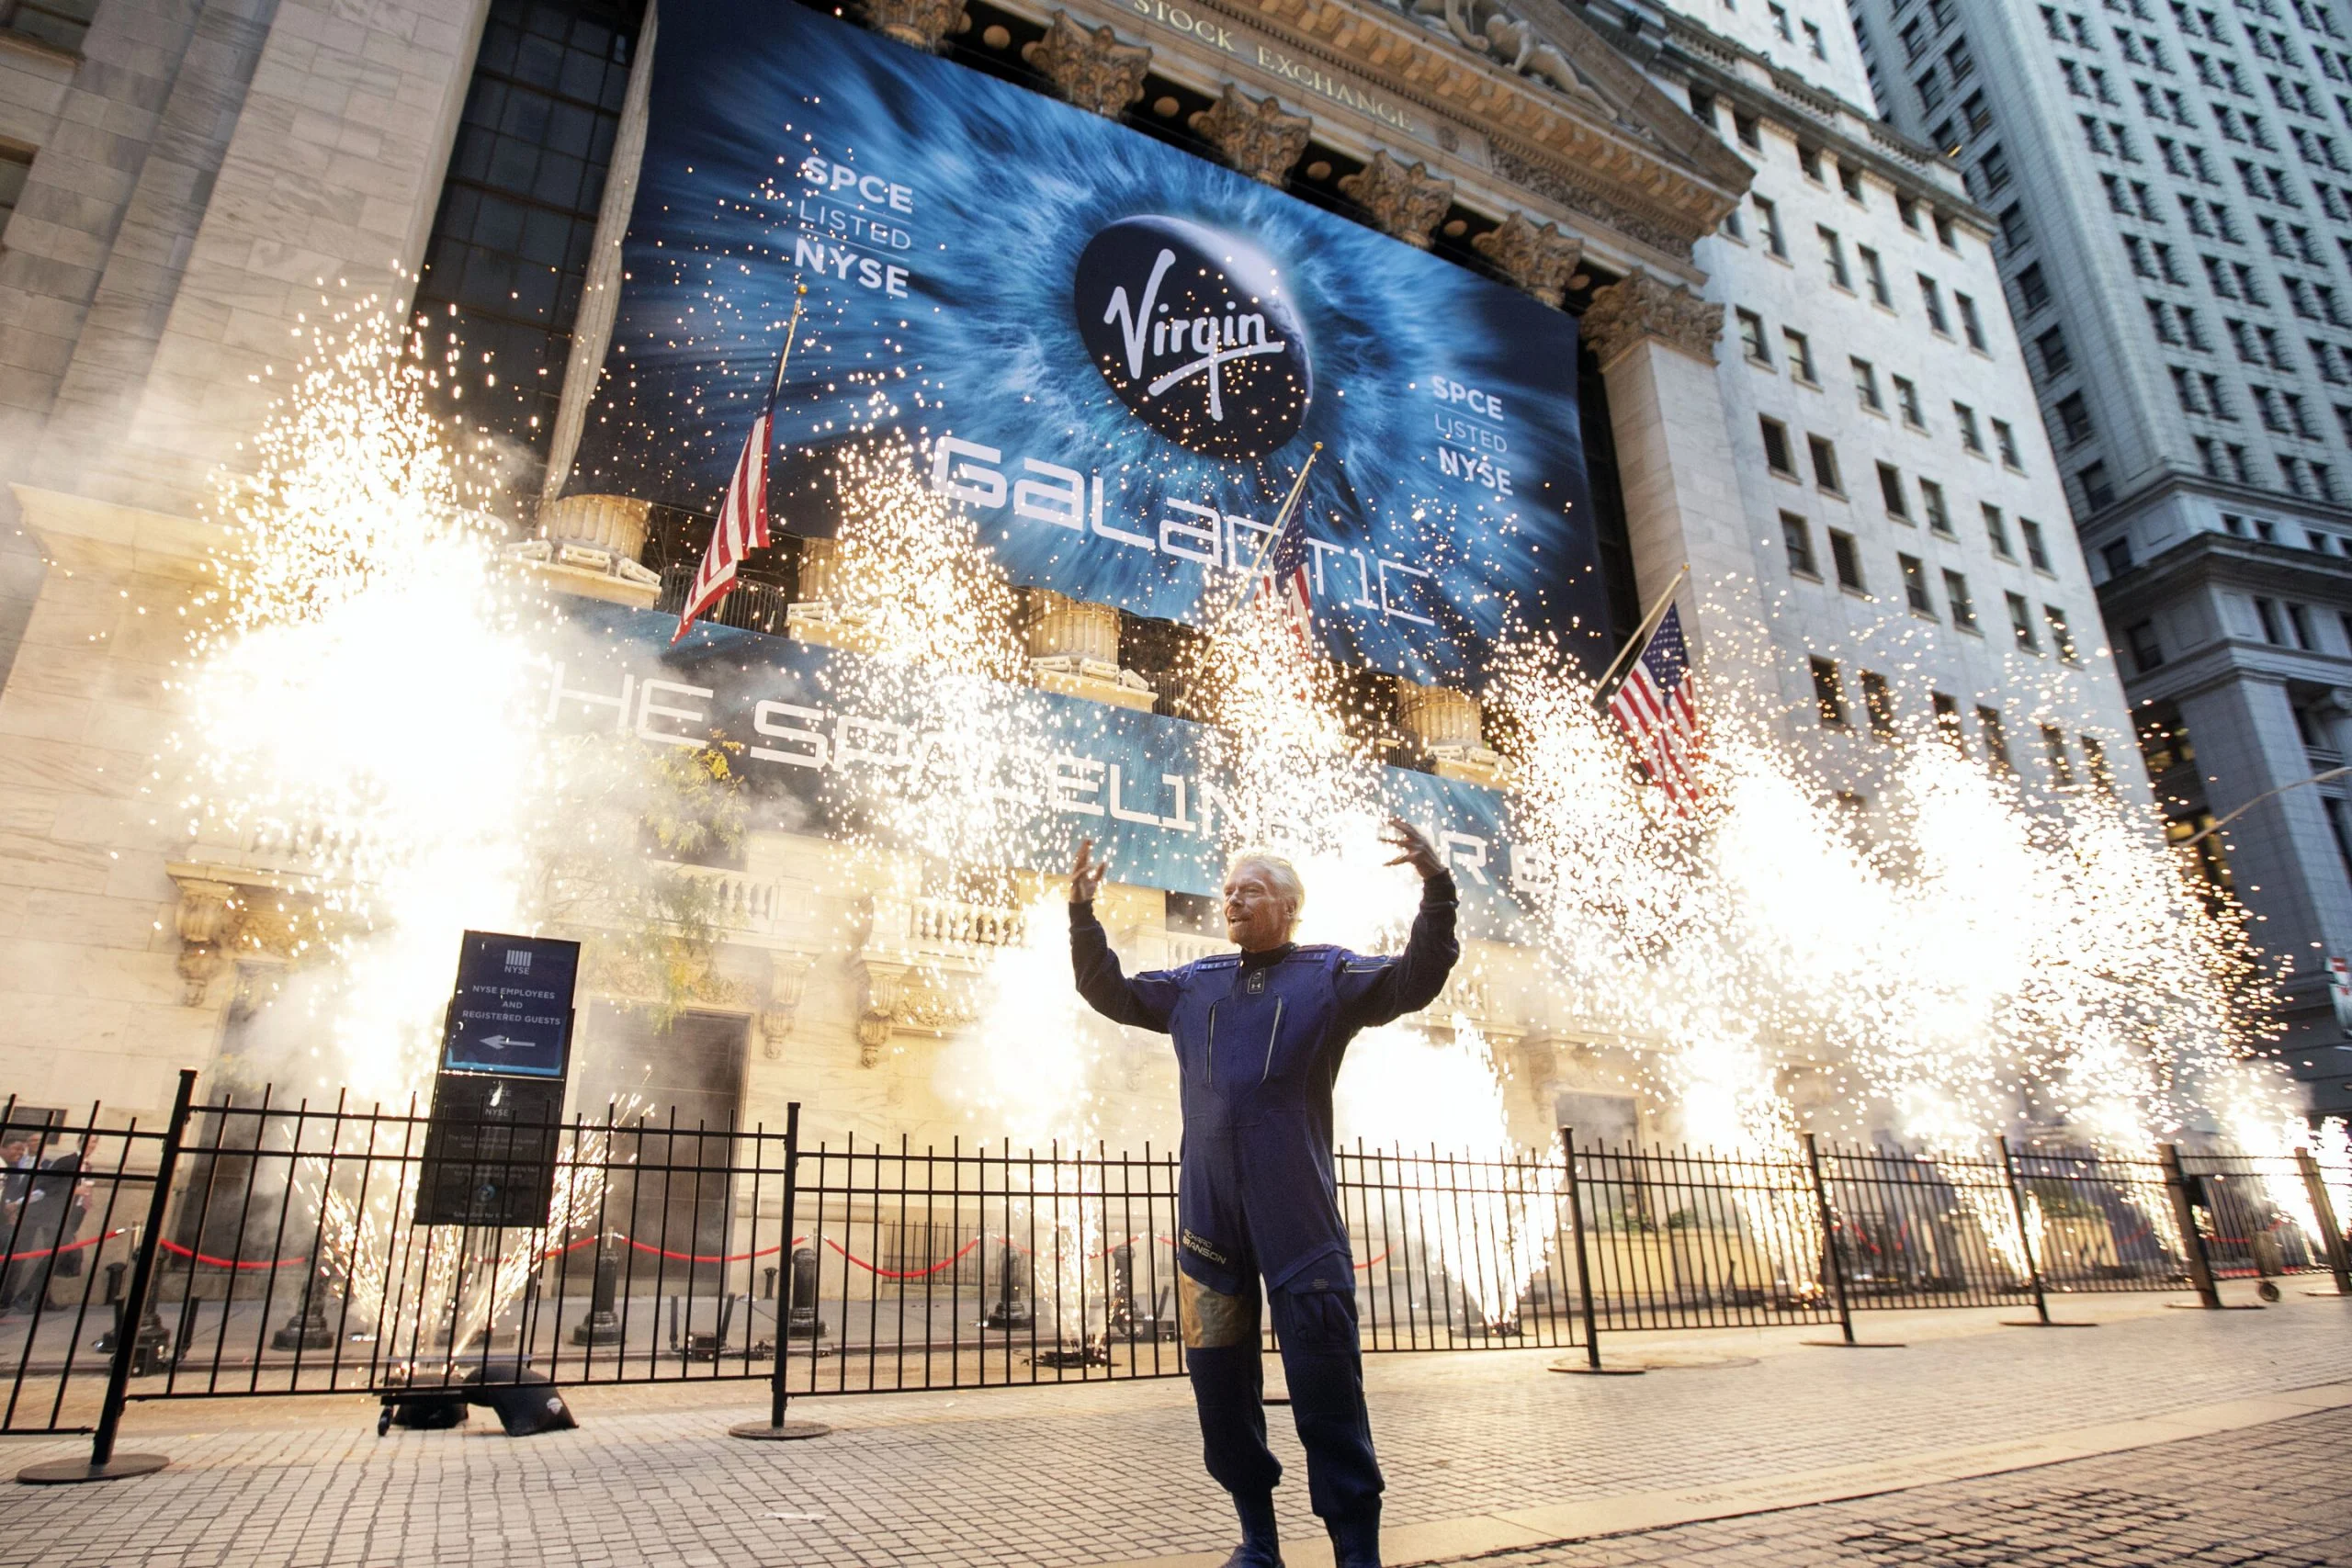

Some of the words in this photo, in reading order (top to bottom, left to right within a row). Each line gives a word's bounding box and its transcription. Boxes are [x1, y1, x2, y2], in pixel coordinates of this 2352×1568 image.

[1134, 0, 1238, 52] STOCK
[1258, 46, 1414, 132] EXCHANGE
[804, 156, 913, 214] SPCE
[799, 199, 911, 250] LISTED
[795, 237, 910, 299] NYSE
[1103, 248, 1284, 422] Virgin
[1431, 375, 1504, 421] SPCE
[1435, 413, 1508, 453] LISTED
[1439, 446, 1514, 496] NYSE
[531, 650, 714, 750] HE
[472, 985, 498, 994] NYSE
[500, 987, 556, 999] EMPLOYEES
[504, 965, 530, 975] NYSE
[462, 1010, 522, 1021] REGISTERED
[525, 1015, 561, 1025] GUESTS
[502, 1000, 523, 1010] AND
[485, 1108, 509, 1117] NYSE
